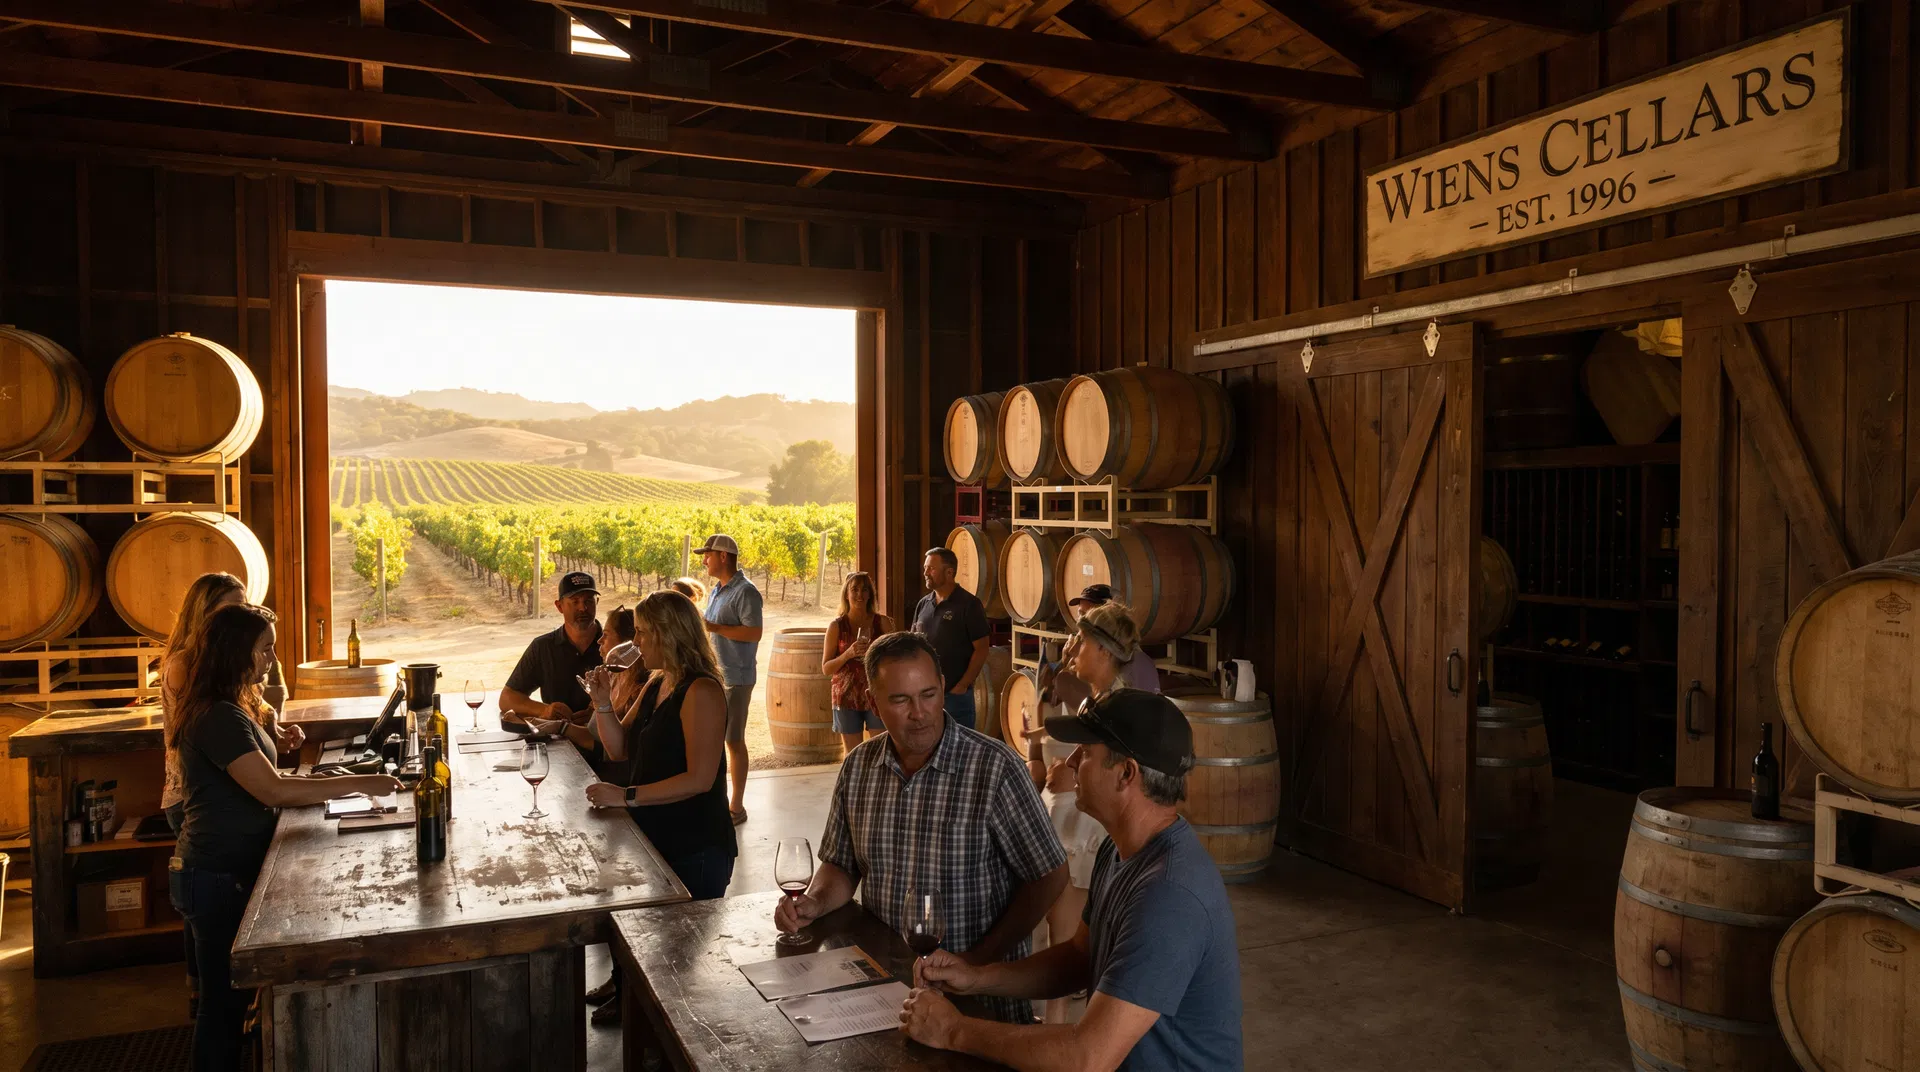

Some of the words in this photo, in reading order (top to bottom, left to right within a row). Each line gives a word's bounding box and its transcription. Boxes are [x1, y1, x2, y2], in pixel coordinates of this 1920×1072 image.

[1377, 146, 1520, 223] WIENS
[1540, 51, 1817, 177] CELLARS
[1496, 194, 1556, 235] EST.
[1566, 172, 1637, 217] 1996
